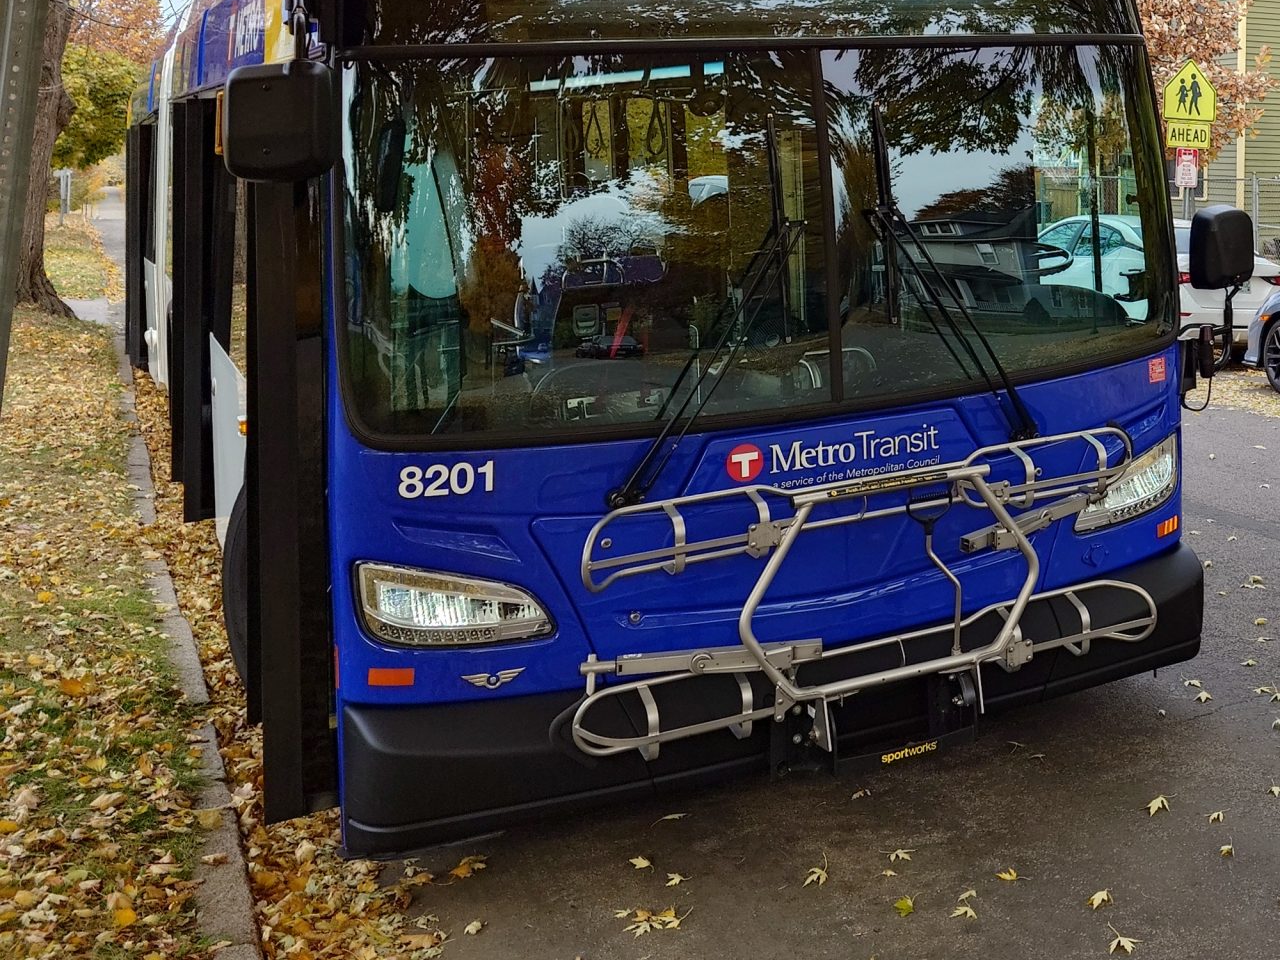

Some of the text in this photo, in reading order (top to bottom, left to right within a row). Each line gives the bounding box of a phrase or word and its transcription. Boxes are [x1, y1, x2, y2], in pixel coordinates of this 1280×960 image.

[1170, 127, 1207, 143] AHEAD
[769, 423, 940, 474] Metro Transit
[398, 460, 495, 499] 8201
[781, 476, 814, 489] service
[816, 473, 827, 484] of
[828, 470, 844, 482] the
[846, 462, 905, 479] Metropolitan
[906, 455, 941, 468] Council
[881, 741, 938, 763] sportworks
